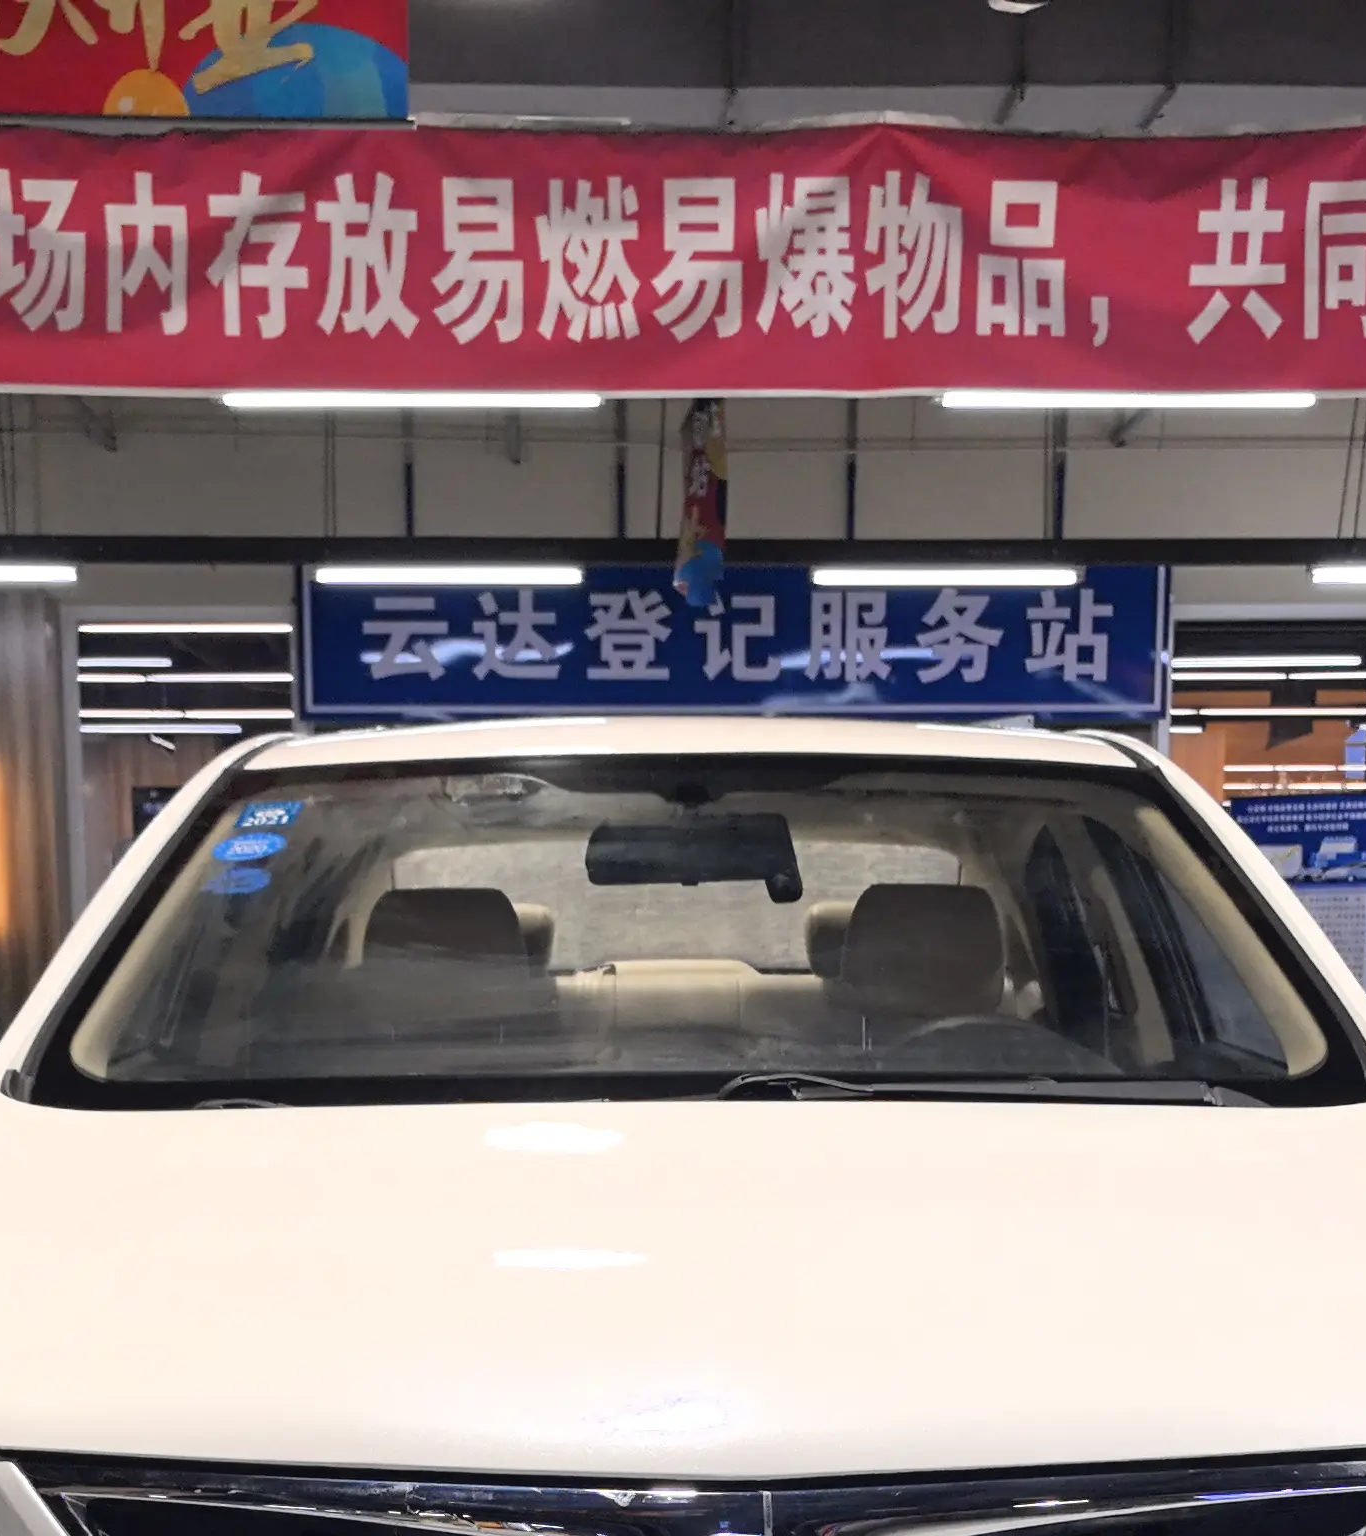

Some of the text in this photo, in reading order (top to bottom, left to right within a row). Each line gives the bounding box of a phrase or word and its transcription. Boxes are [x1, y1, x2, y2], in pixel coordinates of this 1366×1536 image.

[362, 588, 1114, 685] 云达登记服务站
